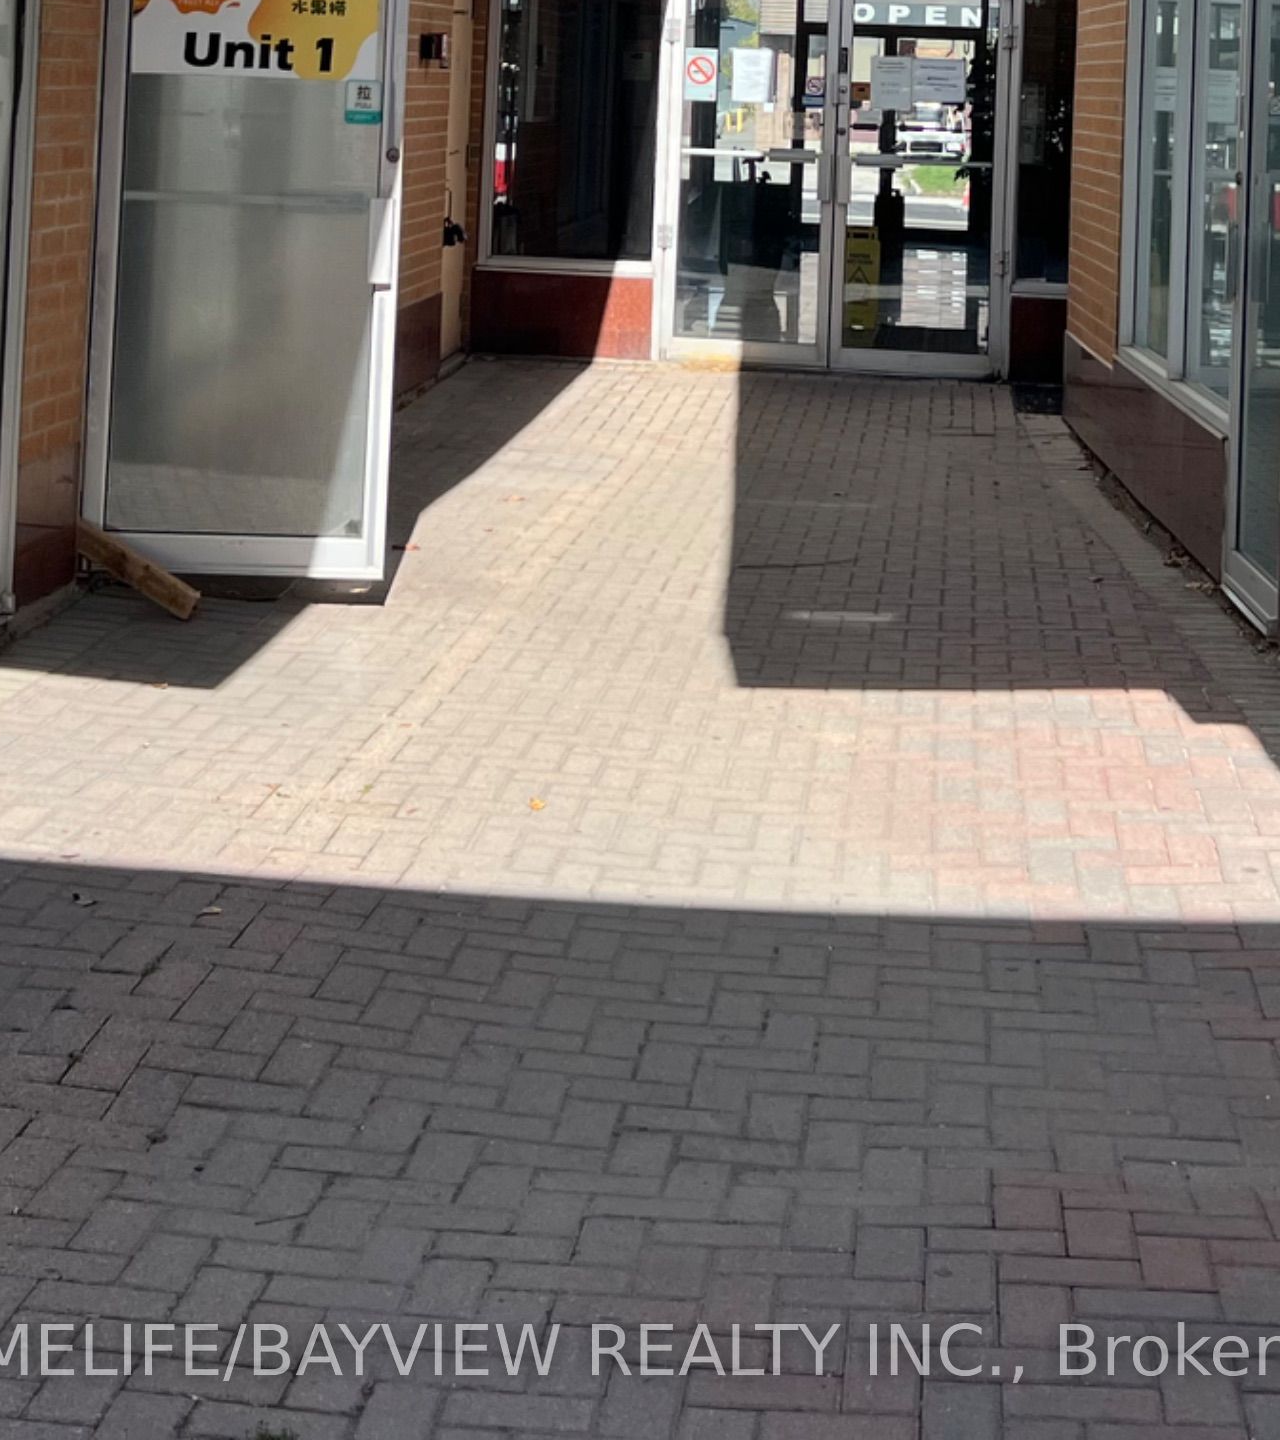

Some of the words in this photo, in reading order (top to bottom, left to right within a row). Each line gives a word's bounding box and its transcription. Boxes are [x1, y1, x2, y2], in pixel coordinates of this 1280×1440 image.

[853, 2, 982, 29] OPEN
[183, 31, 295, 71] Unit
[315, 37, 335, 72] 1
[357, 85, 372, 101] 拉
